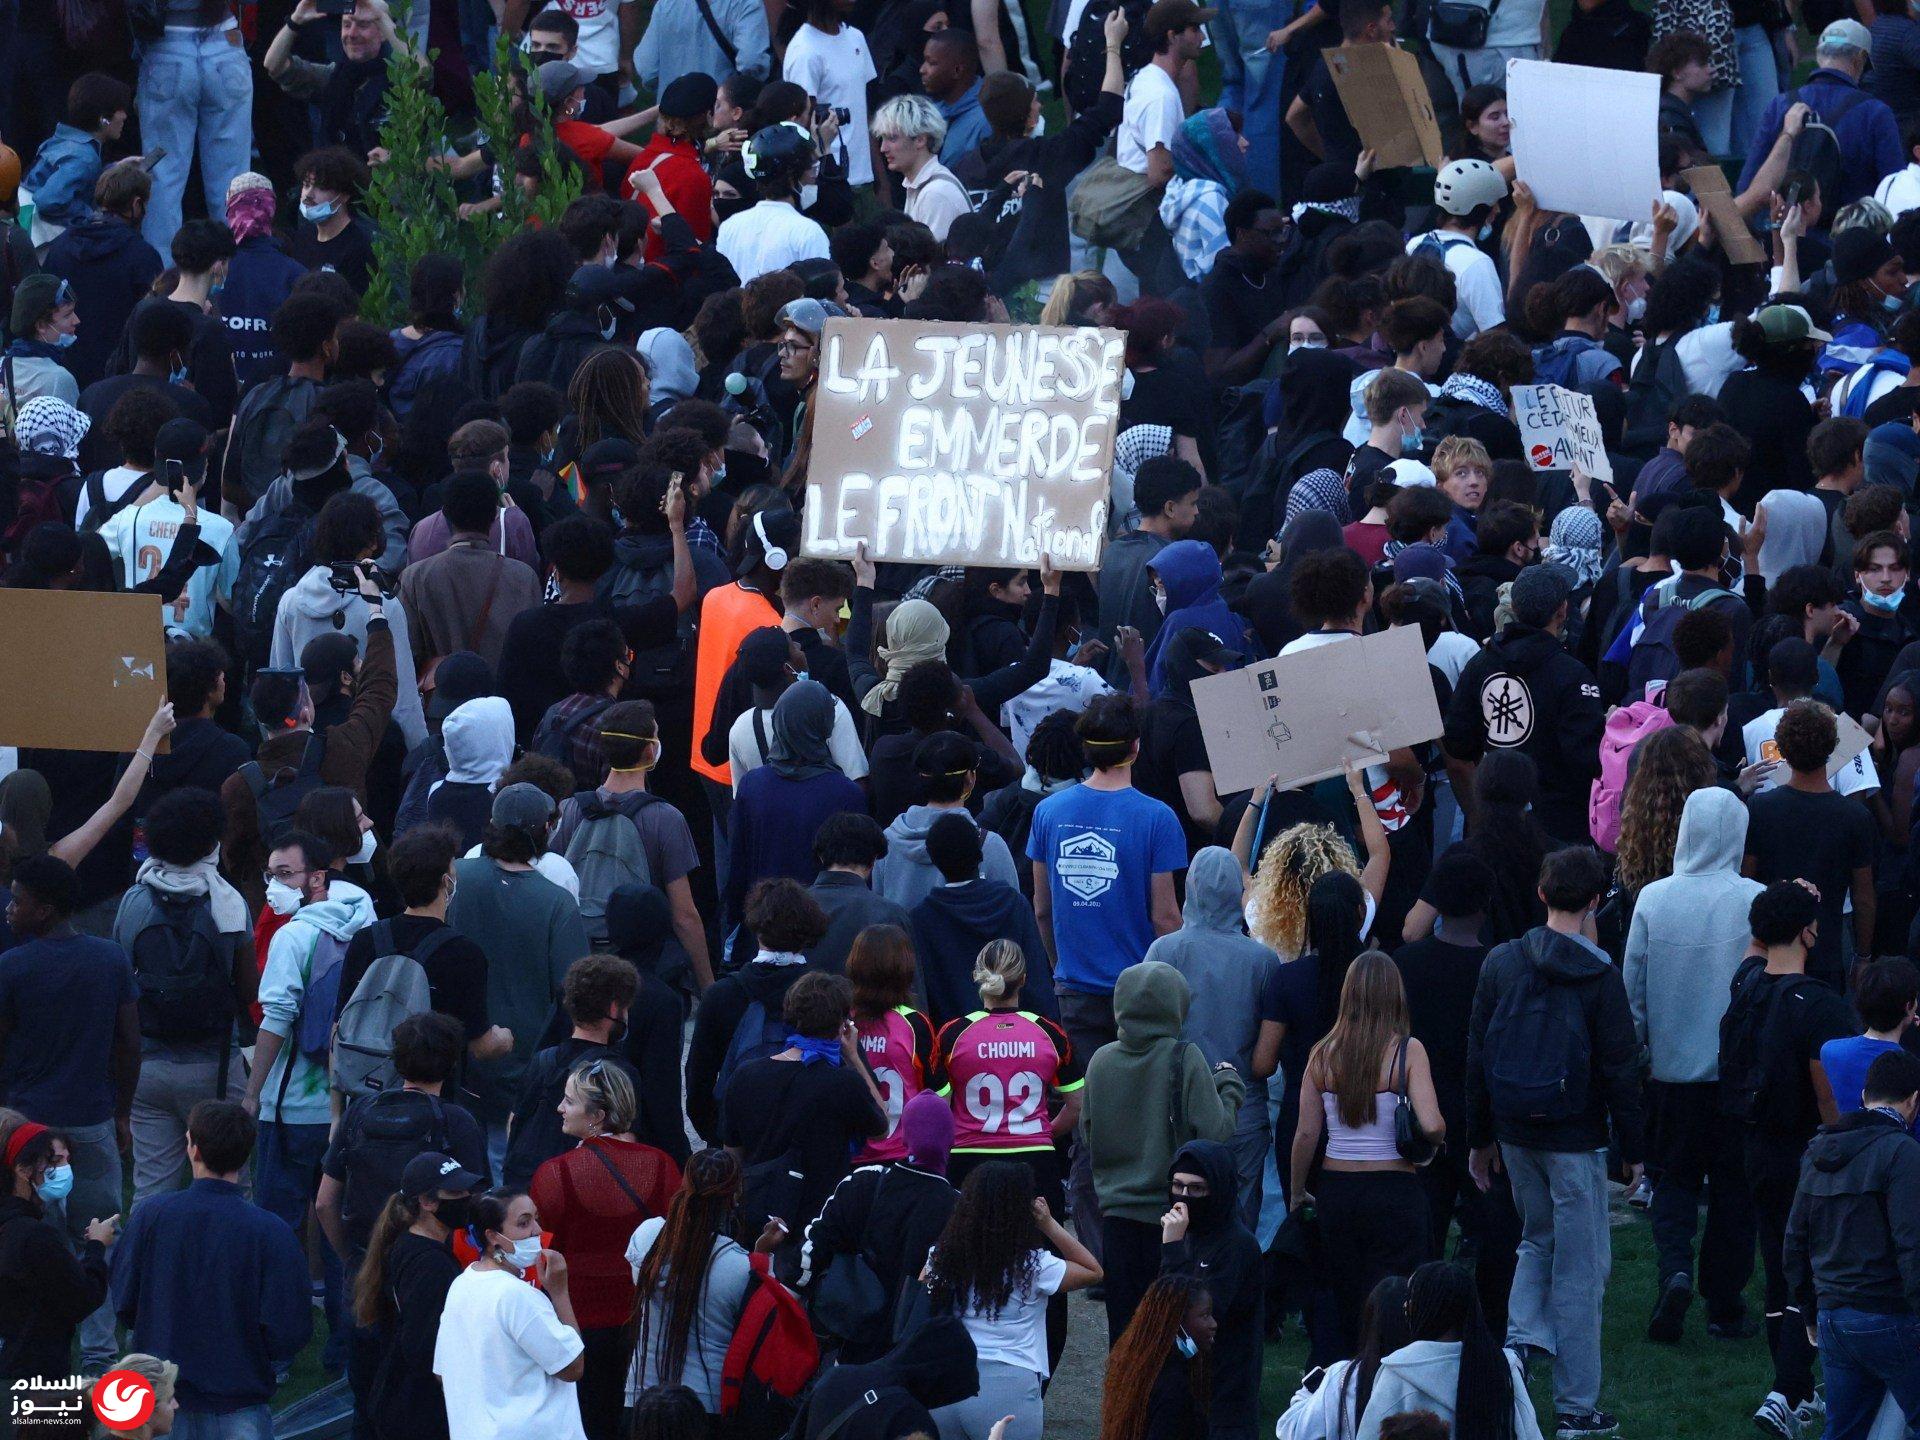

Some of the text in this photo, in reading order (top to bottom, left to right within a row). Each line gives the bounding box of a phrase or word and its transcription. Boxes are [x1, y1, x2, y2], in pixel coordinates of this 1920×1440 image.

[826, 327, 1124, 413] LA JEUNESSE
[1525, 386, 1548, 410] LE
[898, 402, 1110, 482] EMMERDE
[1554, 437, 1595, 474] AVANT
[804, 471, 873, 552] LE
[875, 471, 1002, 559] FRONT
[977, 1041, 1036, 1059] CHOUMI
[965, 1071, 1043, 1135] 92
